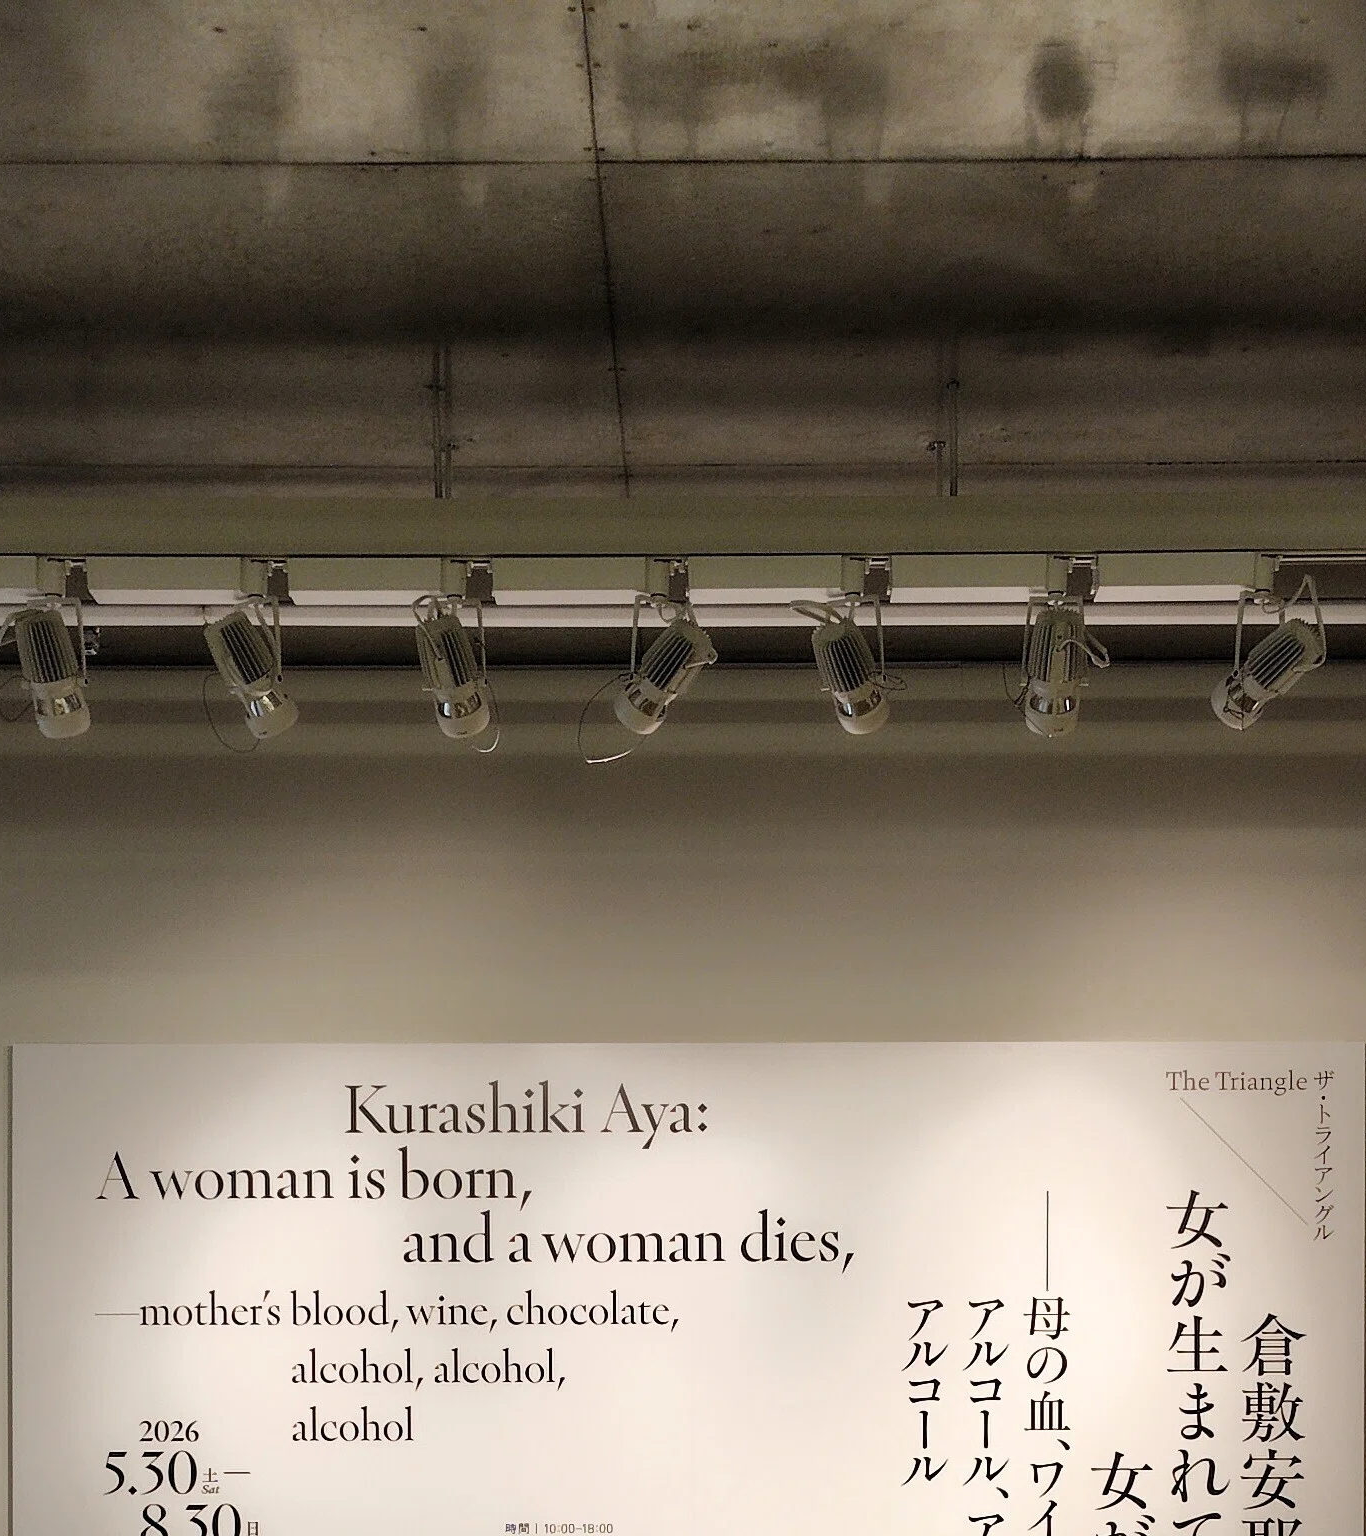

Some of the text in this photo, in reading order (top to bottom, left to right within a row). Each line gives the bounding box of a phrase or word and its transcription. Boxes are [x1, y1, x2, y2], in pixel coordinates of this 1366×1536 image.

[1166, 1069, 1307, 1096] The Triangle
[345, 1080, 707, 1149] Kurashiki Aya:
[1314, 1071, 1334, 1239] ザ・トライアングル
[96, 1146, 531, 1213] A woman is born,
[404, 1209, 854, 1273] and a woman dies,
[291, 1290, 398, 1332] blood,
[406, 1295, 497, 1332] wine,
[507, 1289, 679, 1332] chocolate,
[292, 1348, 565, 1390] alcohol, alcohol,
[902, 1300, 948, 1485] アルコール
[139, 1421, 199, 1442] 2026
[292, 1406, 413, 1441] alcohol
[105, 1450, 197, 1495] 5.30
[201, 1485, 220, 1494] Sat
[248, 1521, 258, 1536] 日
